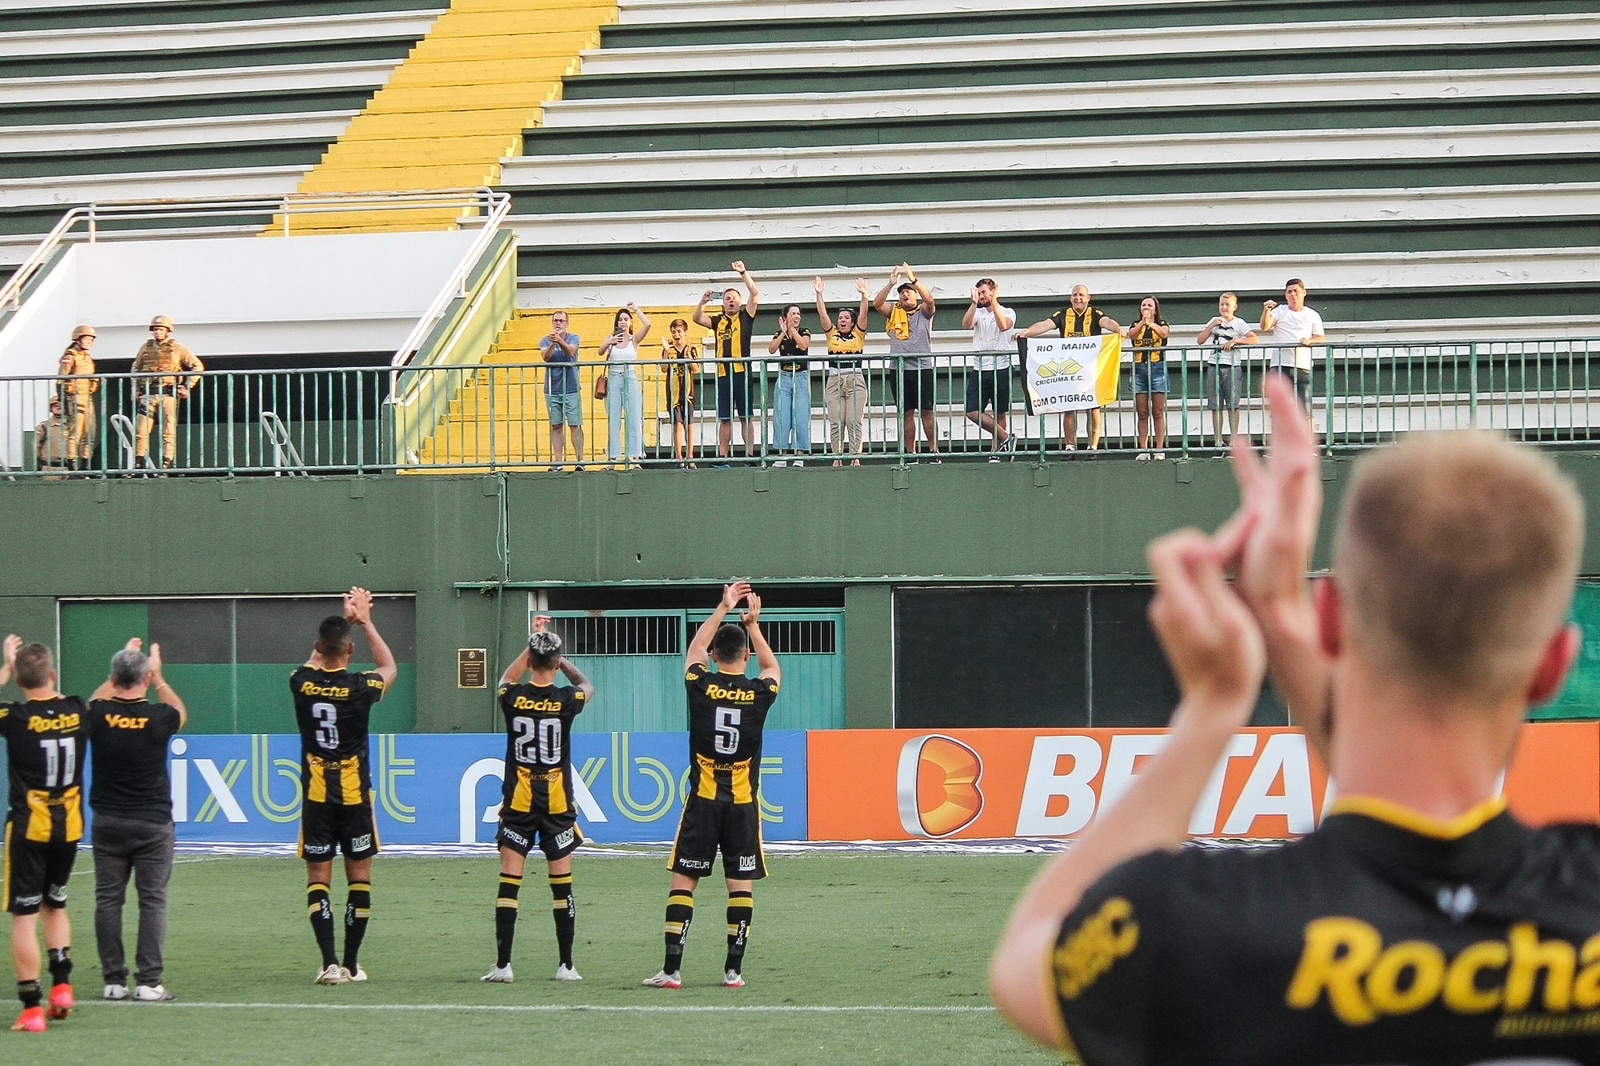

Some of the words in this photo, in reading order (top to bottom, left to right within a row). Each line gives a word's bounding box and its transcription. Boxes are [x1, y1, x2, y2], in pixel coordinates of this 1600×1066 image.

[1036, 344, 1053, 353] RIO
[1061, 342, 1097, 351] MAINA
[1033, 397, 1049, 408] COM
[1050, 396, 1057, 405] O
[1058, 391, 1094, 404] TIGRÃO
[300, 681, 350, 697] Rocha
[705, 684, 755, 701] Rocha
[513, 696, 562, 712] Rocha
[28, 713, 81, 733] Rocha
[105, 713, 149, 729] VOLT
[312, 702, 339, 749] 3
[714, 706, 741, 755] 5
[513, 715, 561, 765] 20
[40, 736, 76, 787] 11
